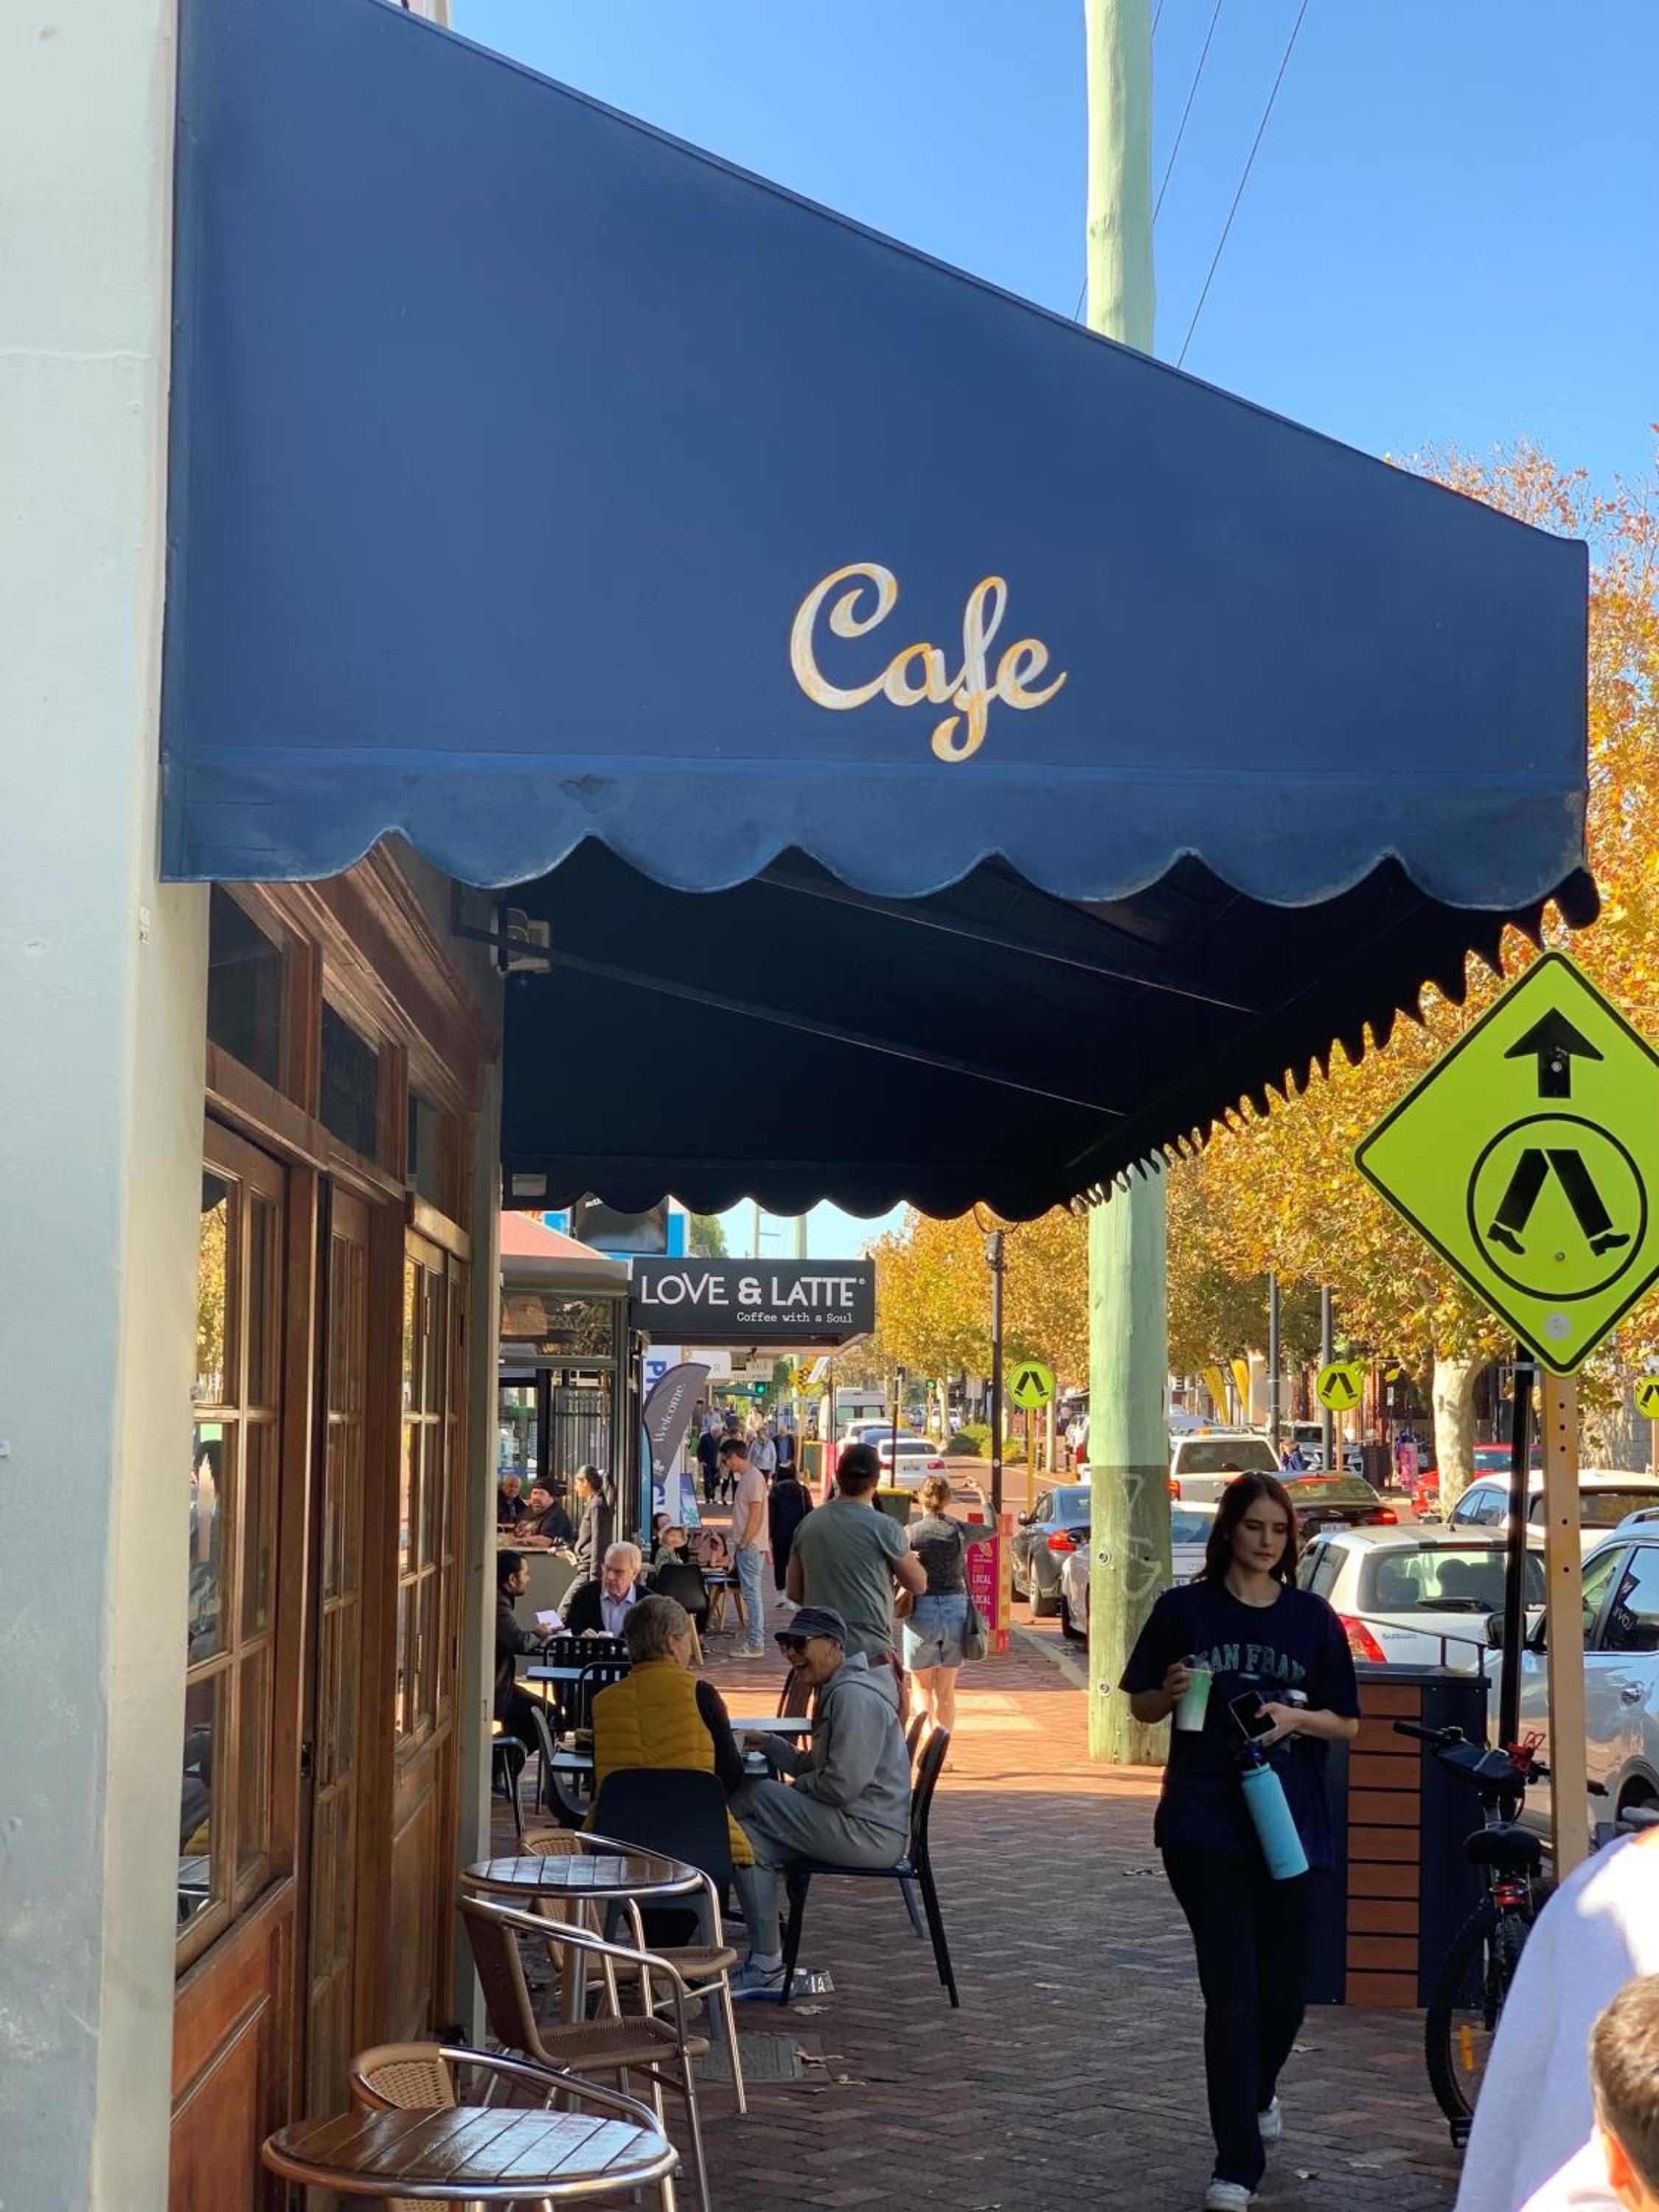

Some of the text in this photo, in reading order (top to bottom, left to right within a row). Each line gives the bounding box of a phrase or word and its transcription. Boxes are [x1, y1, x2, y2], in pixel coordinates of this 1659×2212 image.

[790, 563, 1067, 762] Cafe
[641, 1273, 728, 1305] LOVE
[738, 1277, 762, 1305] &
[737, 1312, 853, 1324] Coffee with a Soul
